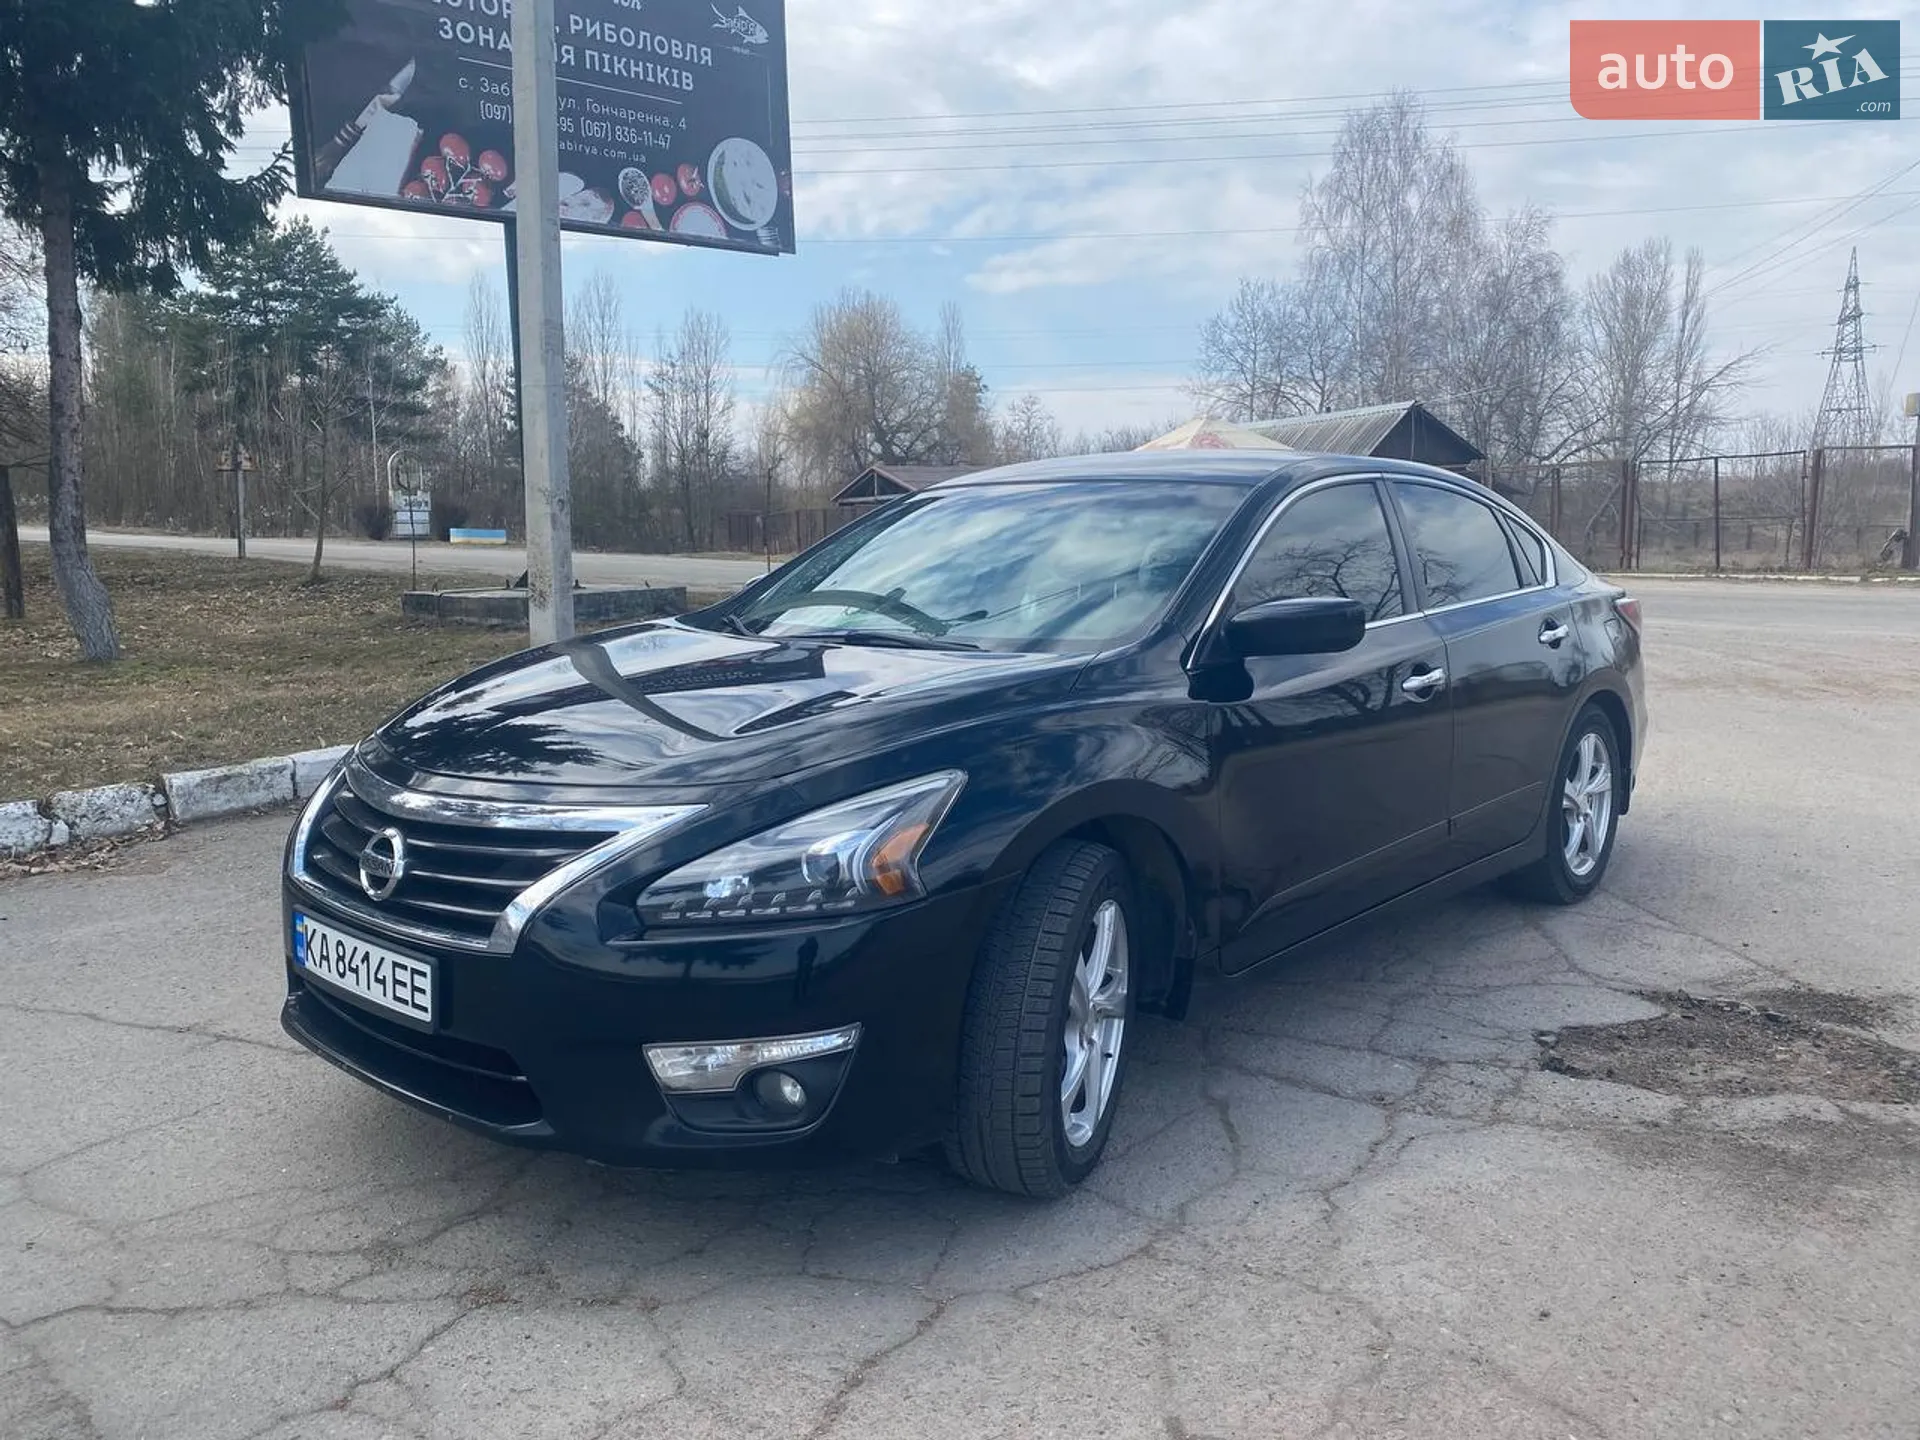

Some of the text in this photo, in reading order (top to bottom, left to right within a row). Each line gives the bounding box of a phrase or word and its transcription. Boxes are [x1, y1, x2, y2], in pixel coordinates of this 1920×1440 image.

[439, 17, 513, 53] ЗОНА
[584, 49, 694, 91] ПІКНІКІВ
[569, 13, 712, 67] РИБОЛОВЛЯ
[480, 76, 511, 97] Заб
[558, 96, 581, 111] ул.
[678, 117, 687, 130] 4
[480, 99, 512, 124] (097)
[580, 116, 612, 142] (067)
[615, 125, 672, 150] 836-11-47
[559, 140, 647, 163] abirya.com.ua
